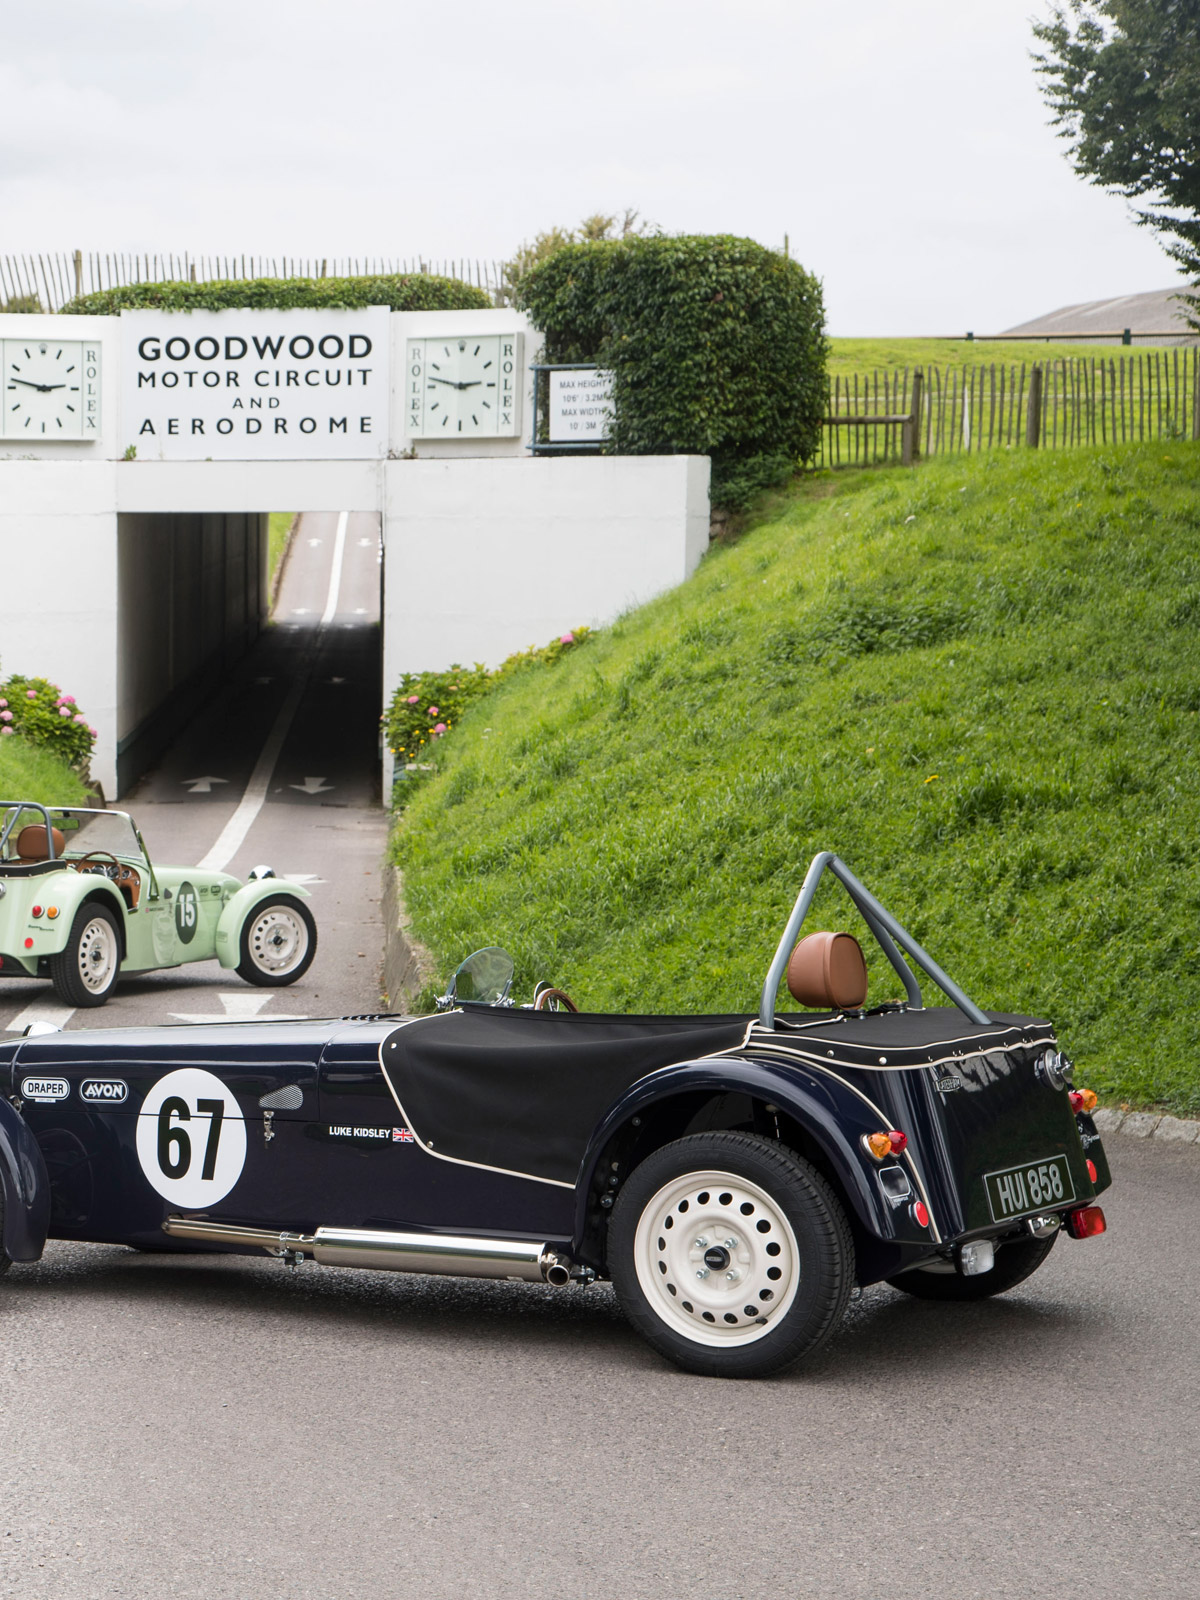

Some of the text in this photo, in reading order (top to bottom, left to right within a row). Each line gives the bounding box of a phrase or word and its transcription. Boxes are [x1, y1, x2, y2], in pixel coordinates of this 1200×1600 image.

[138, 334, 373, 361] GOODWOOD
[137, 369, 373, 388] MOTOR CIRCUIT
[410, 348, 421, 427] ROLEX
[502, 344, 513, 425] ROLEX
[577, 380, 606, 388] HEIGHT
[86, 350, 97, 428] ROLEX
[232, 397, 280, 409] AND
[561, 408, 577, 416] MAX
[139, 416, 372, 435] AERODROME
[178, 893, 196, 928] 15
[28, 1082, 64, 1094] DRAPER
[84, 1083, 123, 1098] AVON
[156, 1095, 225, 1181] 67
[329, 1126, 391, 1138] LUKE KIDSLEY
[996, 1163, 1064, 1215] HUI 858
